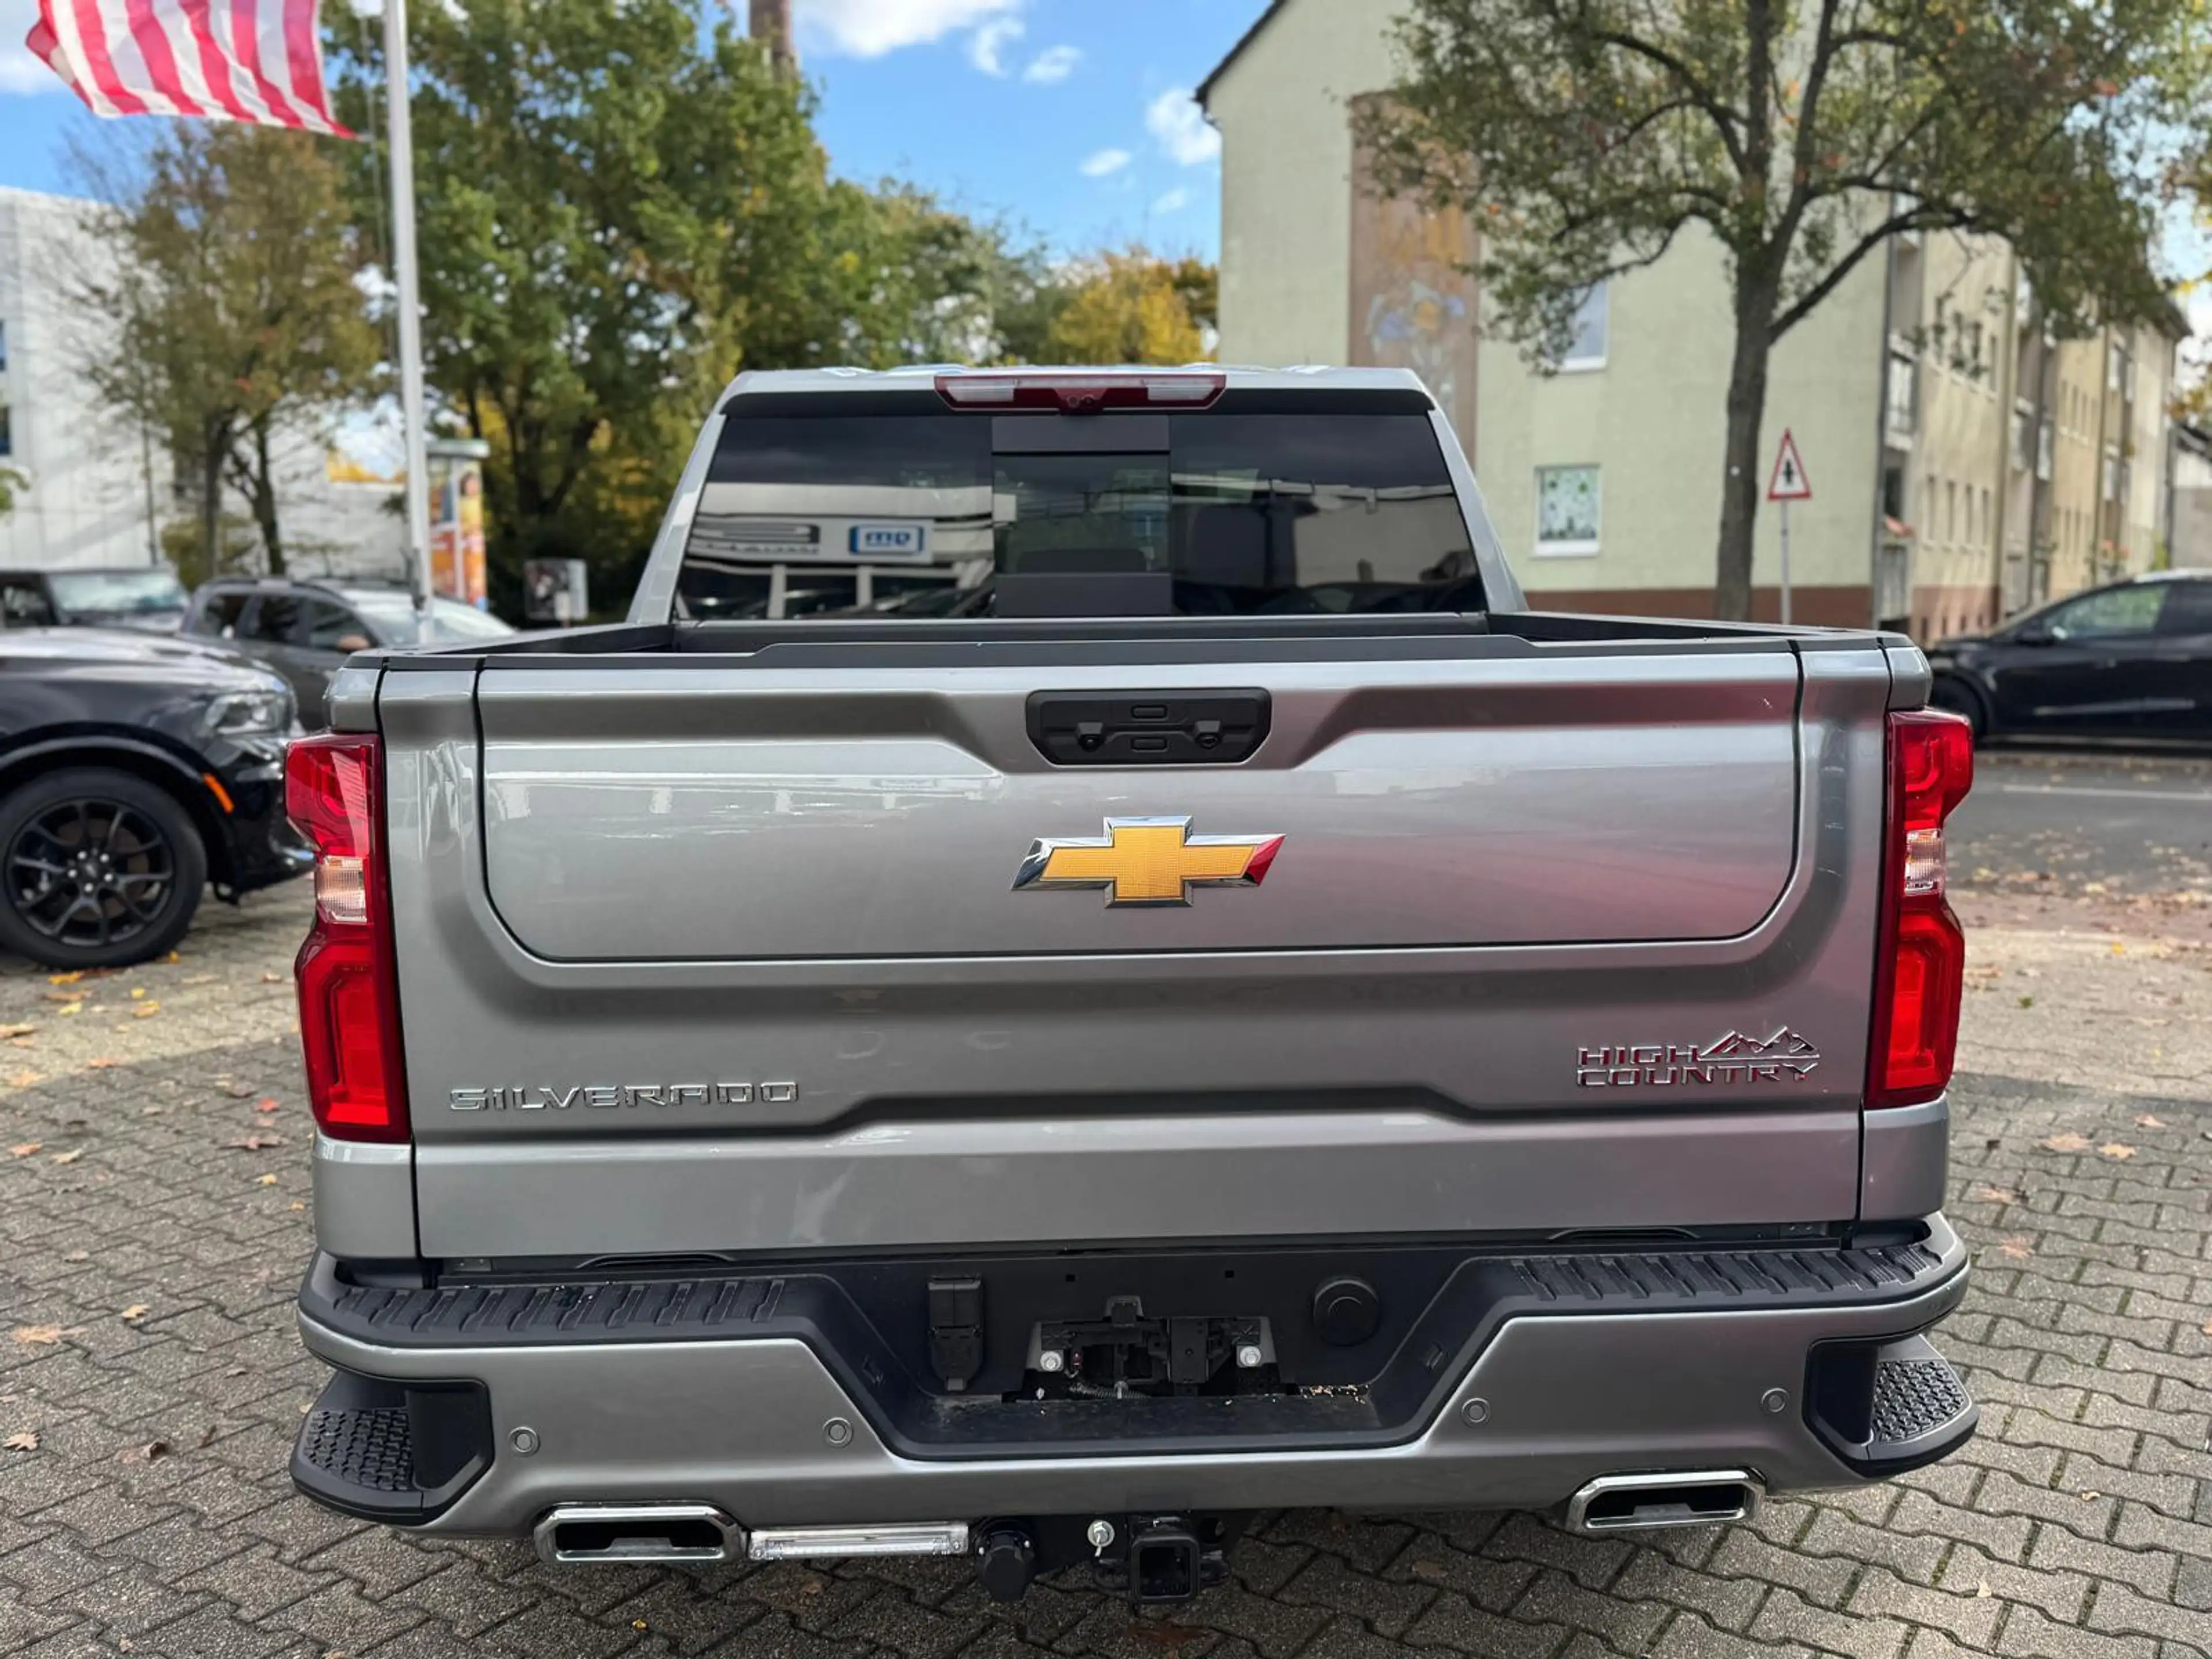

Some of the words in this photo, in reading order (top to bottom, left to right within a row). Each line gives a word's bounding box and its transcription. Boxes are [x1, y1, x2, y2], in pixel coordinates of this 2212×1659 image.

[1577, 1044, 1699, 1066] HIGH
[1577, 1062, 1819, 1086] COUNTRY
[449, 1080, 800, 1112] SILVERADO
